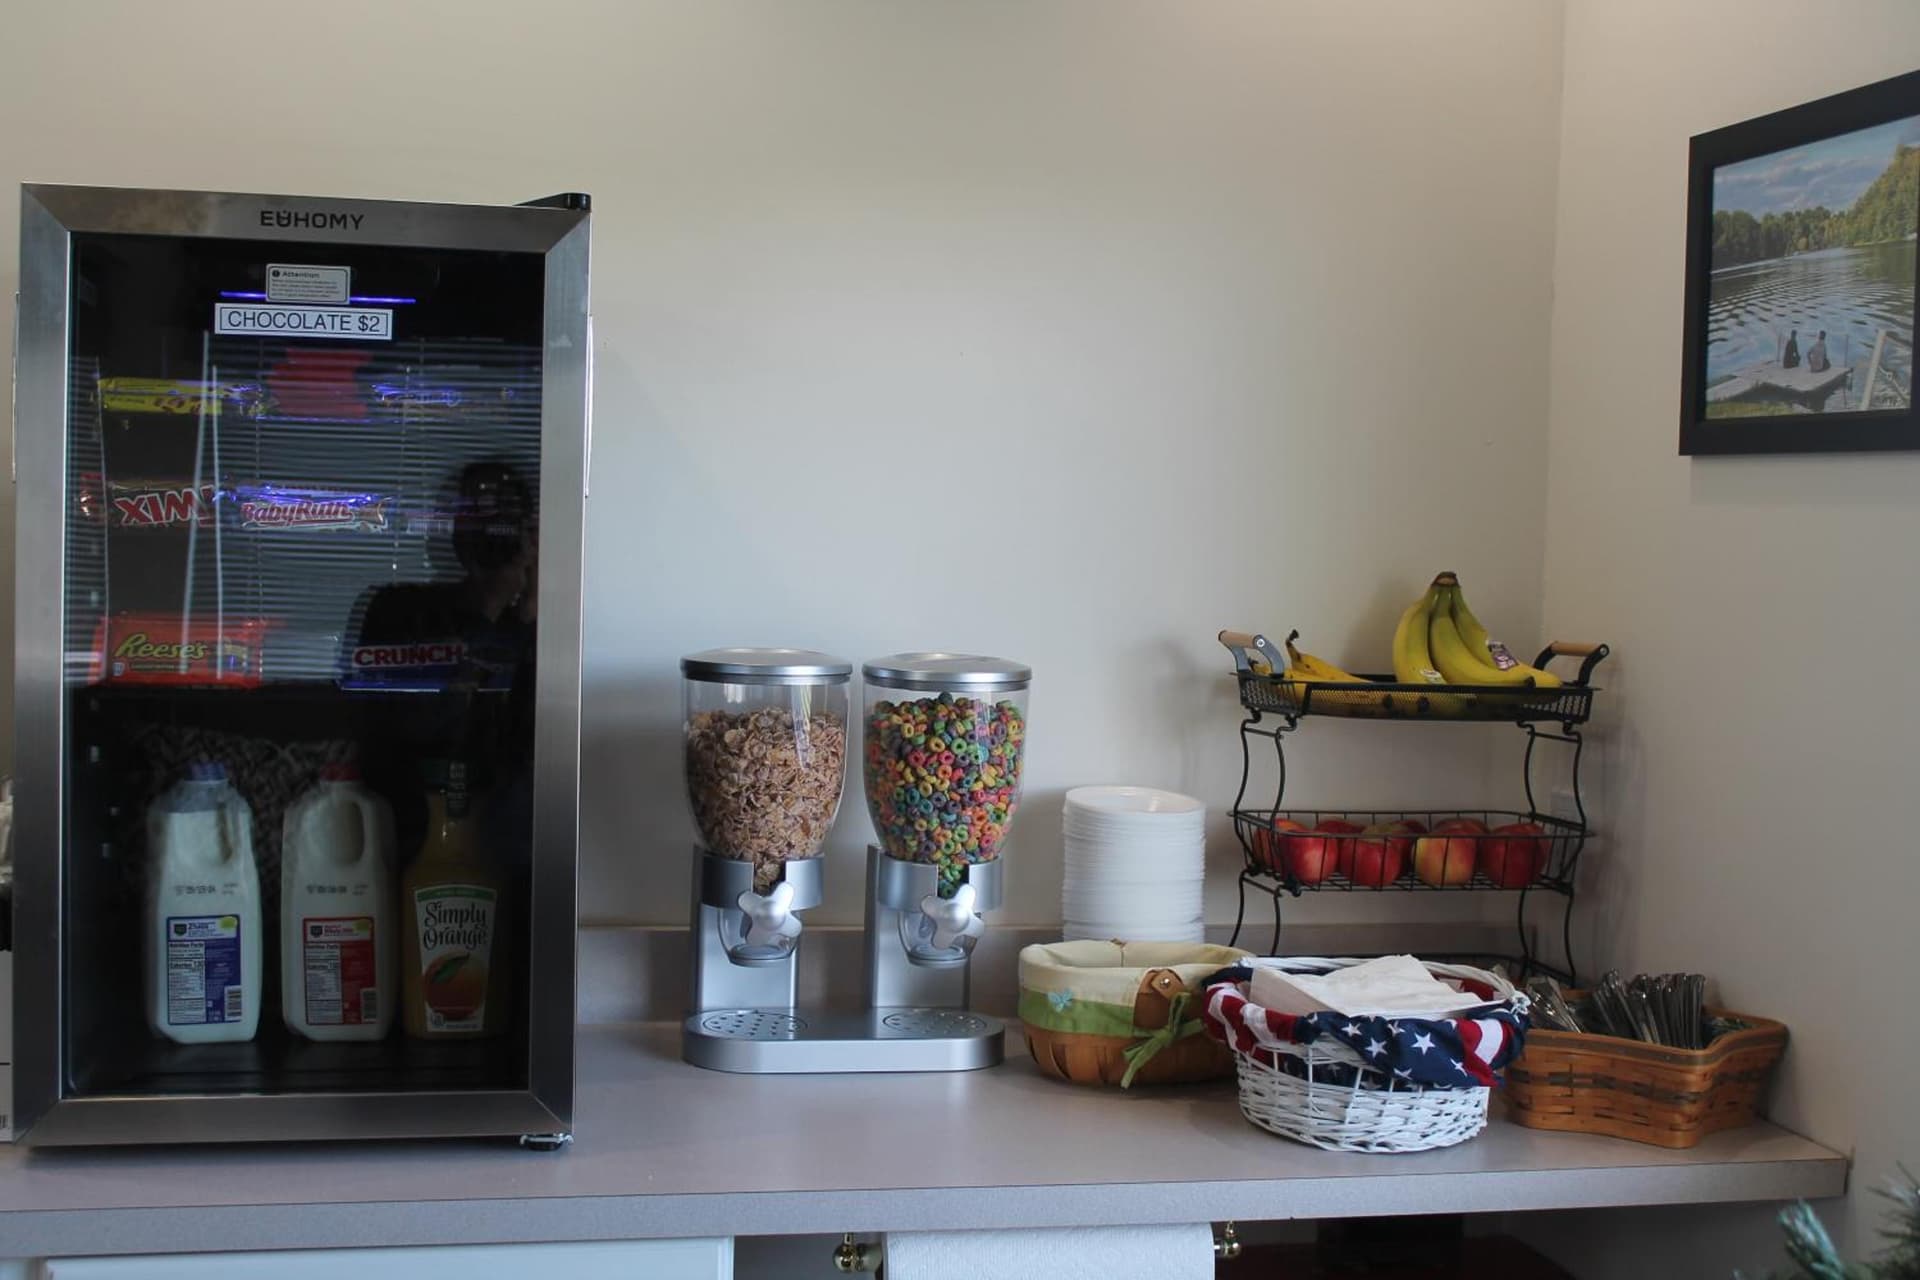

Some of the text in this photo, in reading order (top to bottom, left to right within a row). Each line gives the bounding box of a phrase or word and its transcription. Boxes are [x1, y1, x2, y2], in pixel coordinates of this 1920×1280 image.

[227, 310, 381, 333] CHOCOLATE $2
[354, 644, 463, 667] CRUNCH
[424, 901, 487, 930] Simply
[423, 926, 488, 950] Orange
